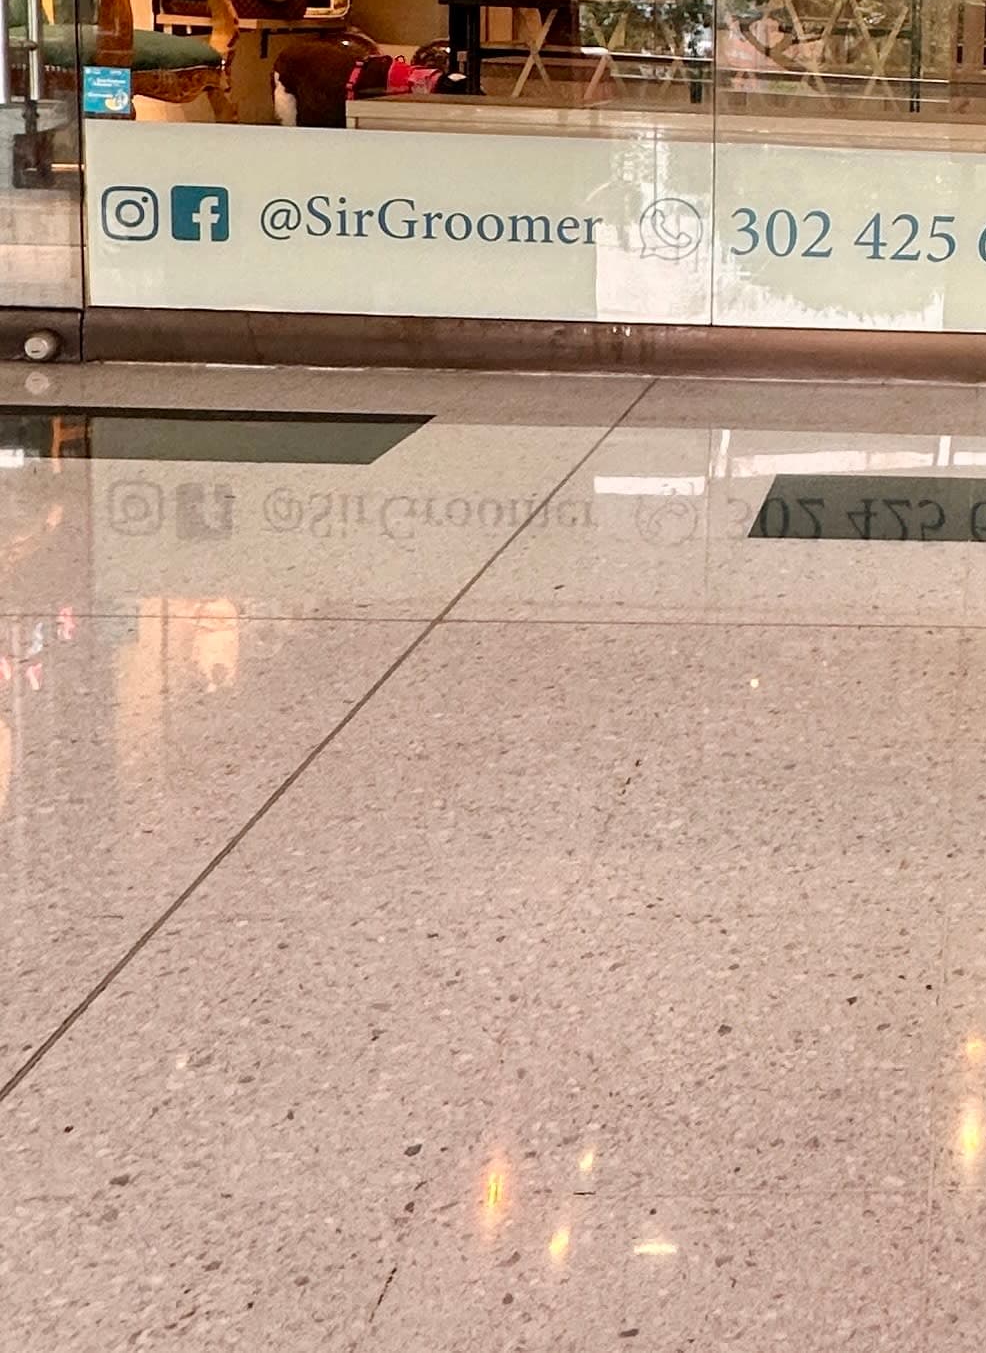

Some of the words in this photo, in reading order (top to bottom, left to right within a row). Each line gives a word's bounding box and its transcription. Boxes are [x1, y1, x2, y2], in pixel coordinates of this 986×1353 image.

[260, 194, 603, 245] @SirGroomer
[730, 207, 833, 258] 302
[853, 212, 958, 263] 425
